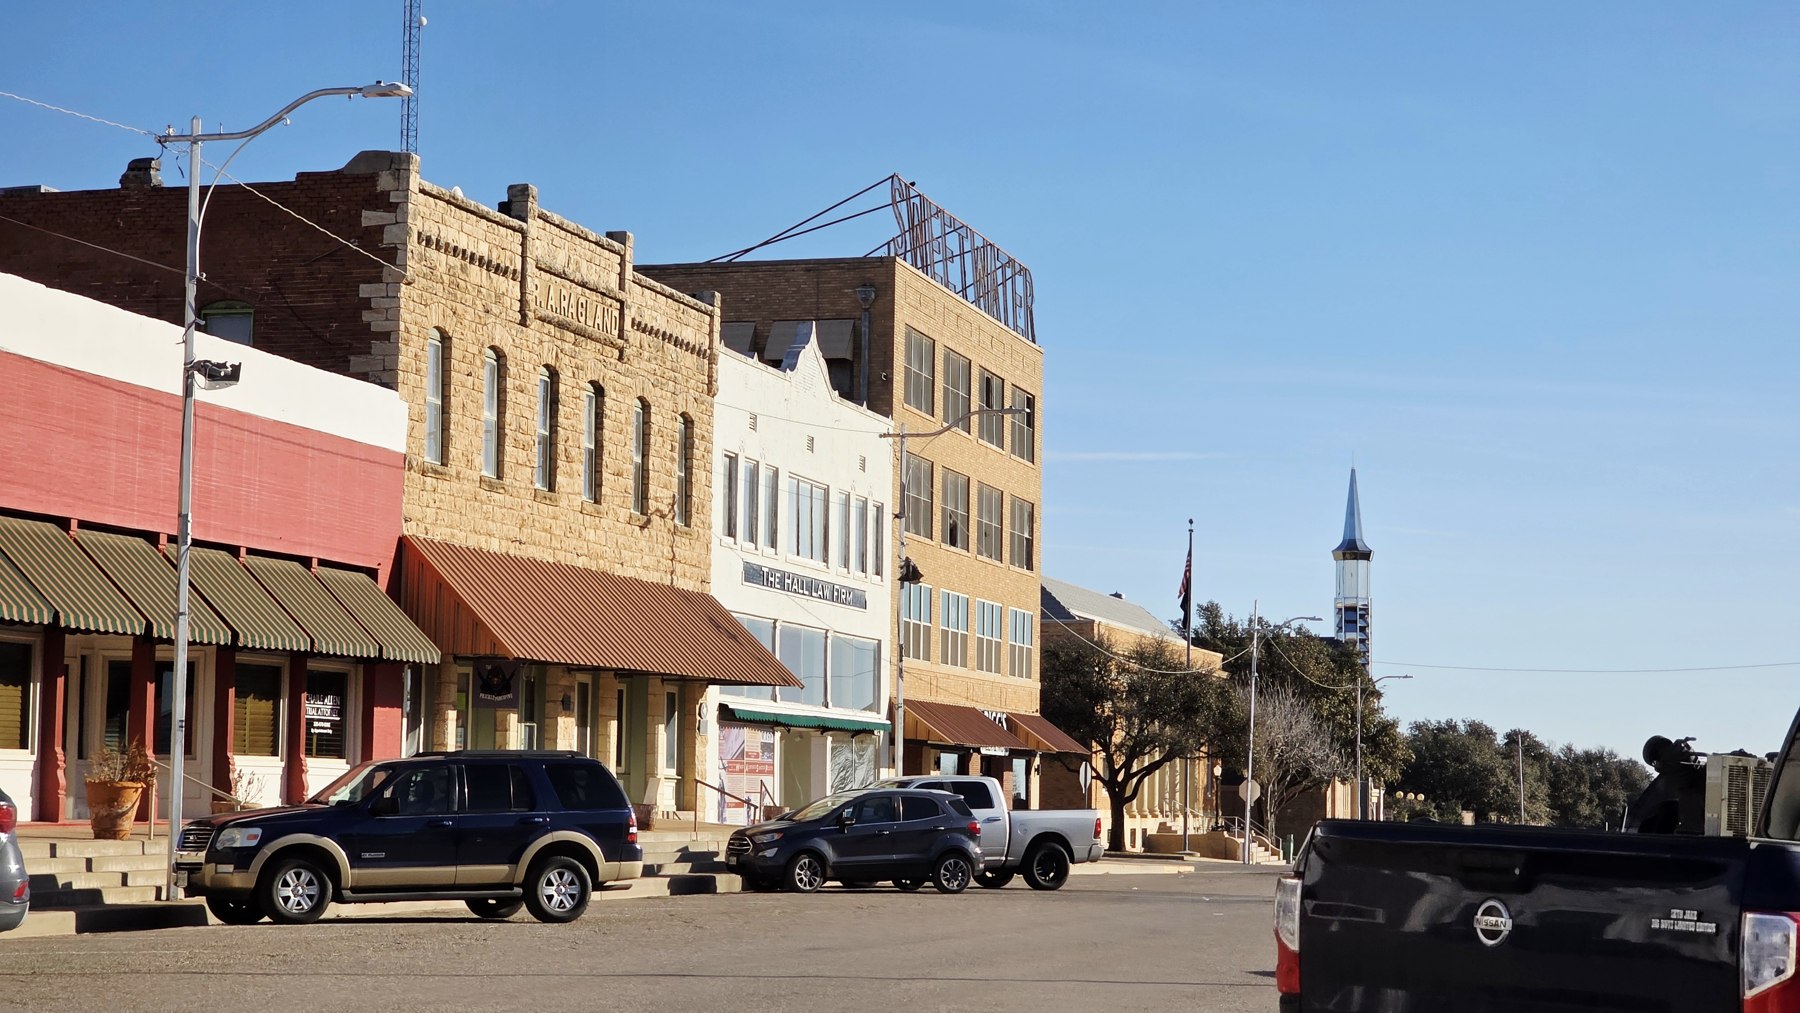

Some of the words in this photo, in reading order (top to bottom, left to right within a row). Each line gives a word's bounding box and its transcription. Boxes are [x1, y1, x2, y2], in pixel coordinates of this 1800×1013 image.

[559, 287, 618, 337] RAGLAND
[761, 566, 780, 588] THE
[784, 571, 809, 596] HALL
[811, 579, 831, 600] LAW
[833, 584, 853, 606] FIRM
[1475, 918, 1507, 928] NISSAN
